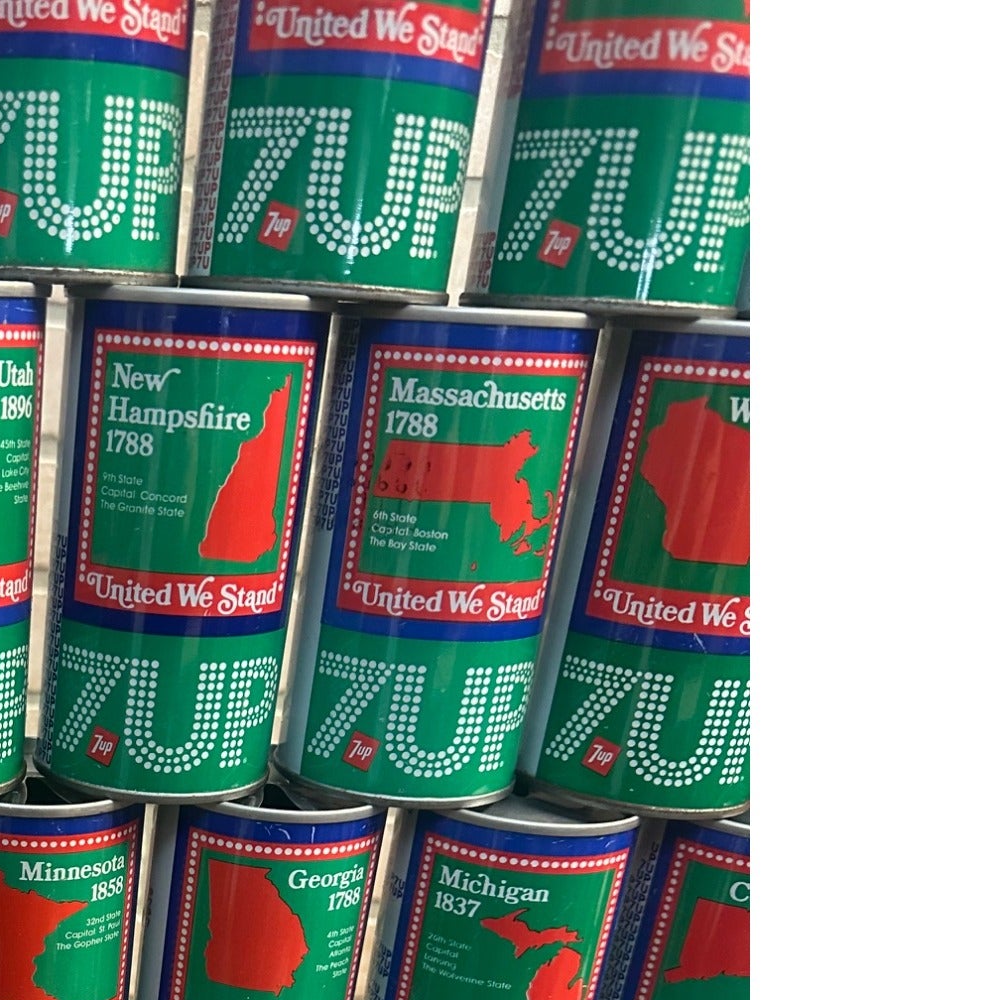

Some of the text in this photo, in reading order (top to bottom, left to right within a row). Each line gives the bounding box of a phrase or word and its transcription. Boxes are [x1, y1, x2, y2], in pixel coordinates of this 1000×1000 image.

[265, 3, 477, 62] United We Stand
[558, 28, 708, 67] United We
[218, 107, 469, 259] 7UP
[265, 211, 290, 237] 7up
[544, 232, 571, 255] 7up
[112, 363, 181, 391] New
[389, 377, 566, 411] Massachusetts
[0, 395, 32, 419] 1896
[108, 396, 251, 433] Hampshire
[385, 411, 438, 437] 1788
[0, 440, 15, 449] 45th
[106, 429, 153, 456] 1788
[2, 468, 18, 478] Lake
[103, 472, 143, 486] 9th State
[101, 500, 185, 517] The Granite State
[140, 491, 188, 503] Concord
[373, 510, 417, 524] 6th State
[370, 536, 436, 552] The Bay State
[414, 529, 448, 539] Boston
[87, 572, 277, 615] United We Stand
[307, 650, 534, 778] 7UP
[350, 738, 373, 760] 7up
[19, 854, 124, 881] Minnesota
[288, 864, 364, 889] Georgia
[90, 877, 123, 902] 1858
[438, 865, 549, 904] Michigan
[327, 887, 360, 911] 1788
[434, 891, 481, 918] 1837
[86, 910, 121, 926] 32nd State
[74, 937, 103, 948] Gopher
[104, 931, 119, 941] State
[423, 962, 436, 973] The
[487, 980, 511, 989] State
